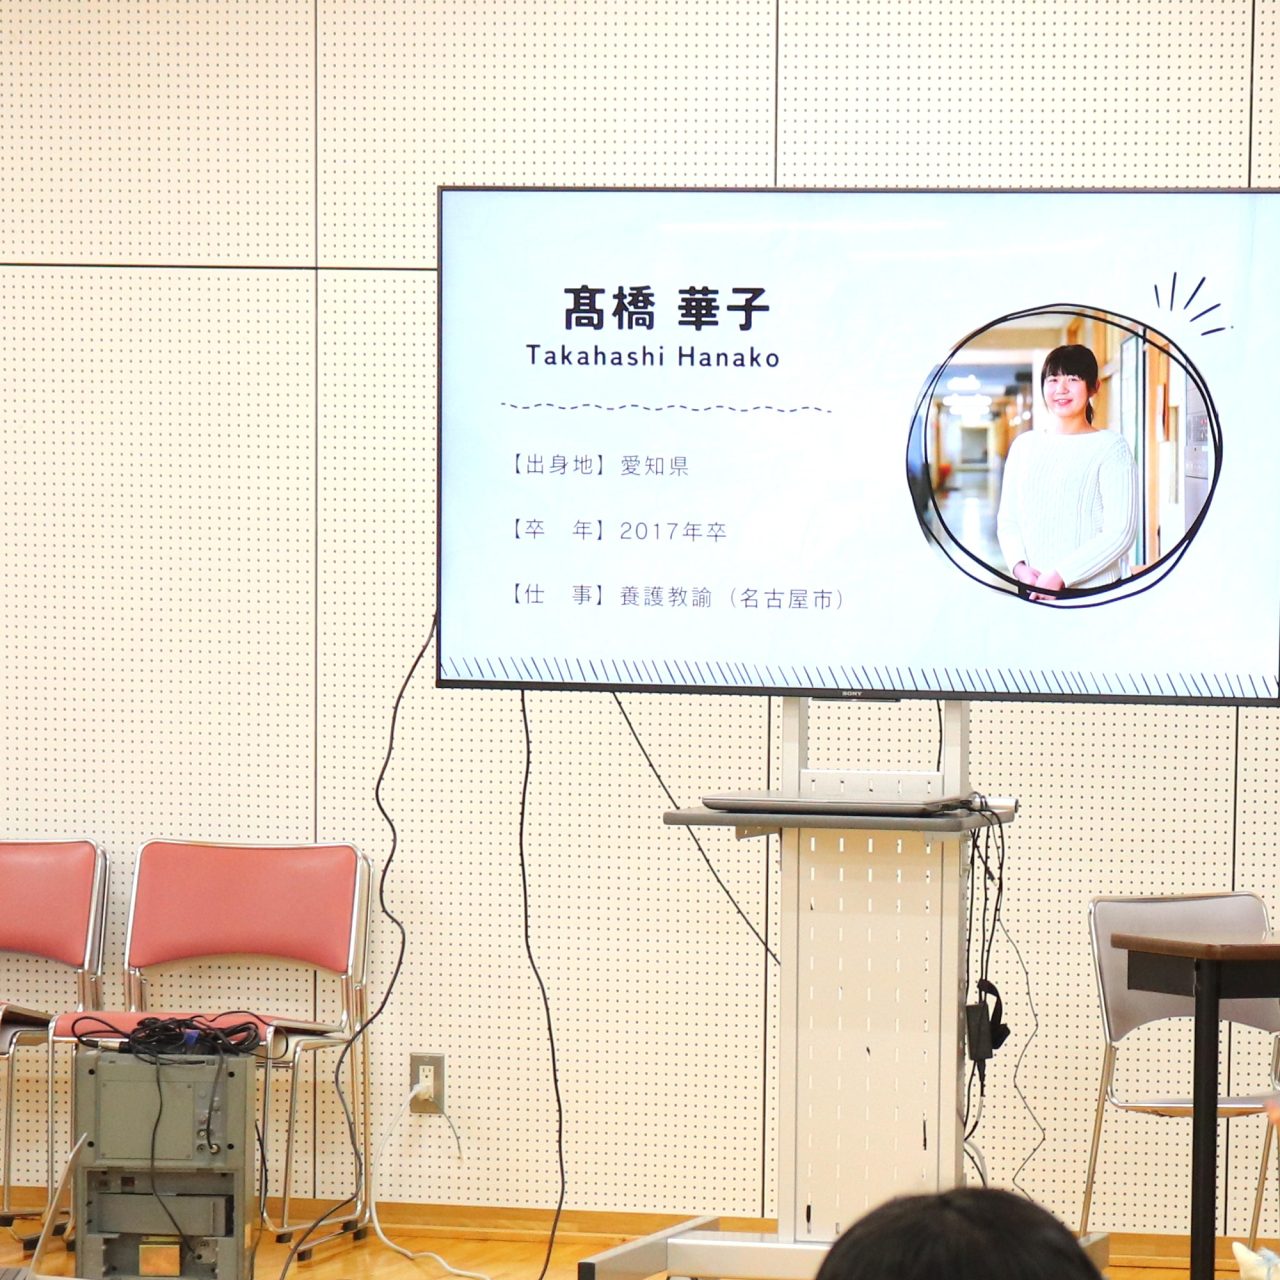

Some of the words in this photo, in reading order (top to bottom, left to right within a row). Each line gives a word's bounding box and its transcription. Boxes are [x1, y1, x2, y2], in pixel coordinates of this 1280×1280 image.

[677, 285, 771, 331] 華子
[525, 344, 664, 367] Takahashi
[678, 346, 780, 369] Hanako
